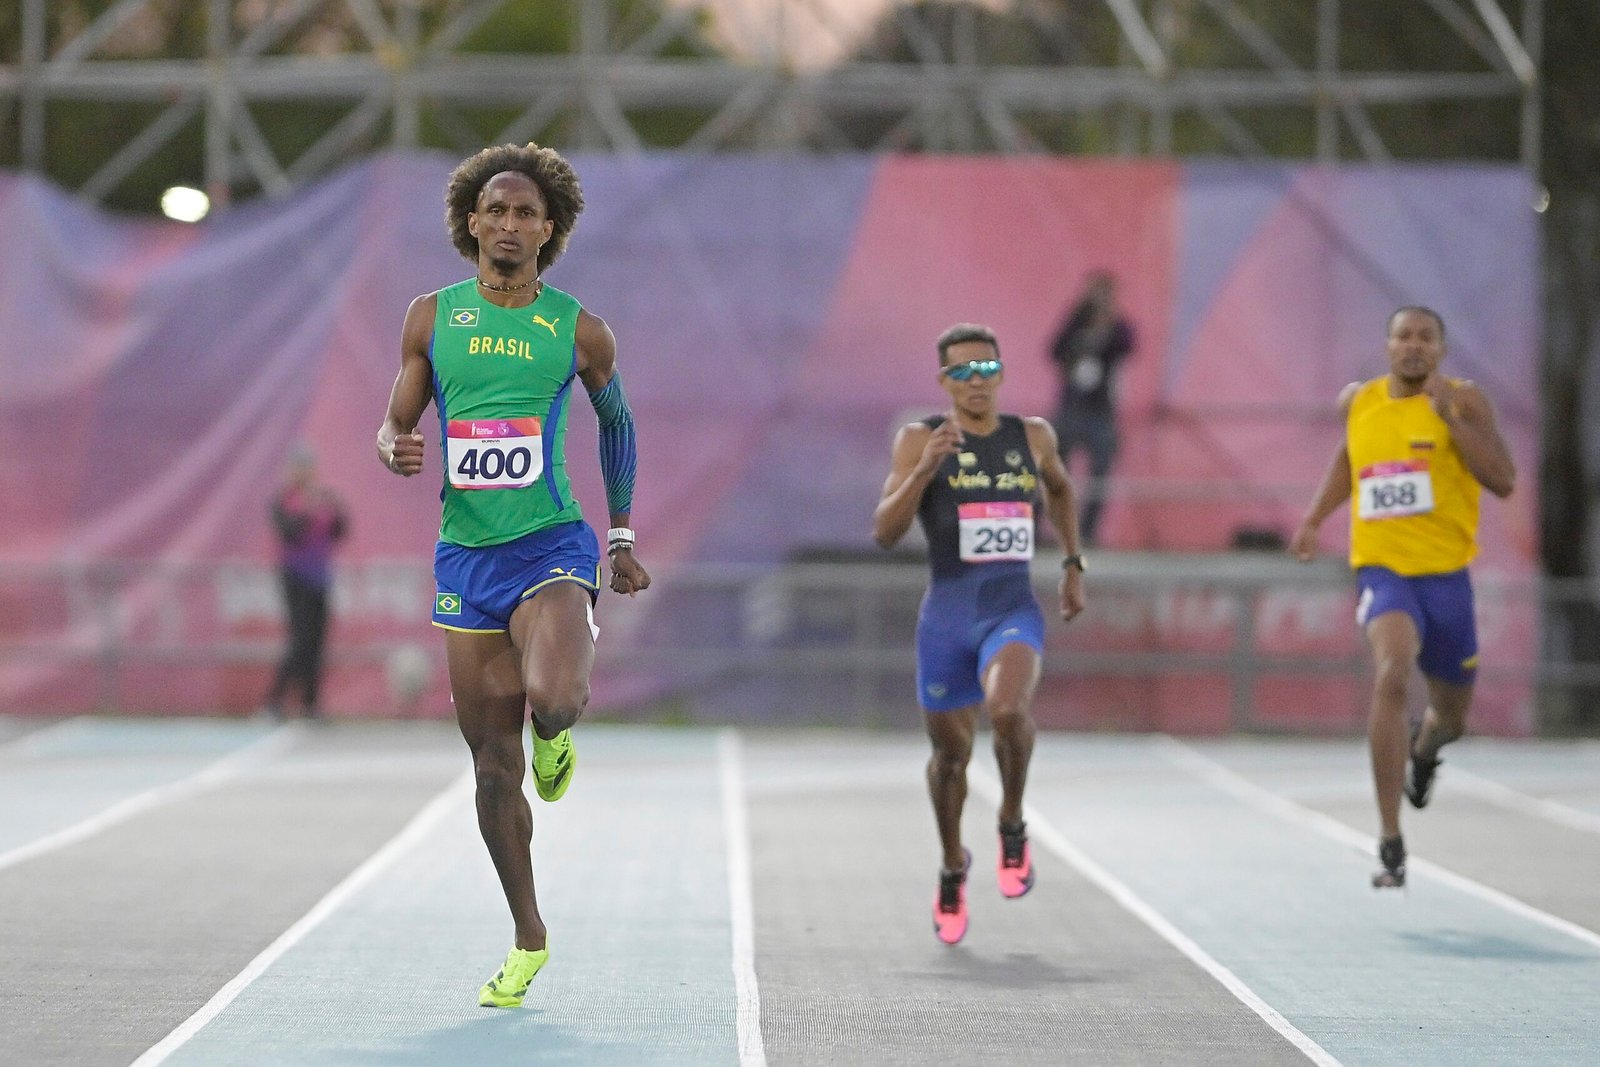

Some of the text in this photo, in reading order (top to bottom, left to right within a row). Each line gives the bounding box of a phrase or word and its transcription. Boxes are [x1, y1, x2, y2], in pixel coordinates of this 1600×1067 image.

[469, 336, 534, 361] BRASIL
[457, 446, 532, 480] 400
[1371, 481, 1417, 510] 168
[972, 526, 1030, 554] 299
